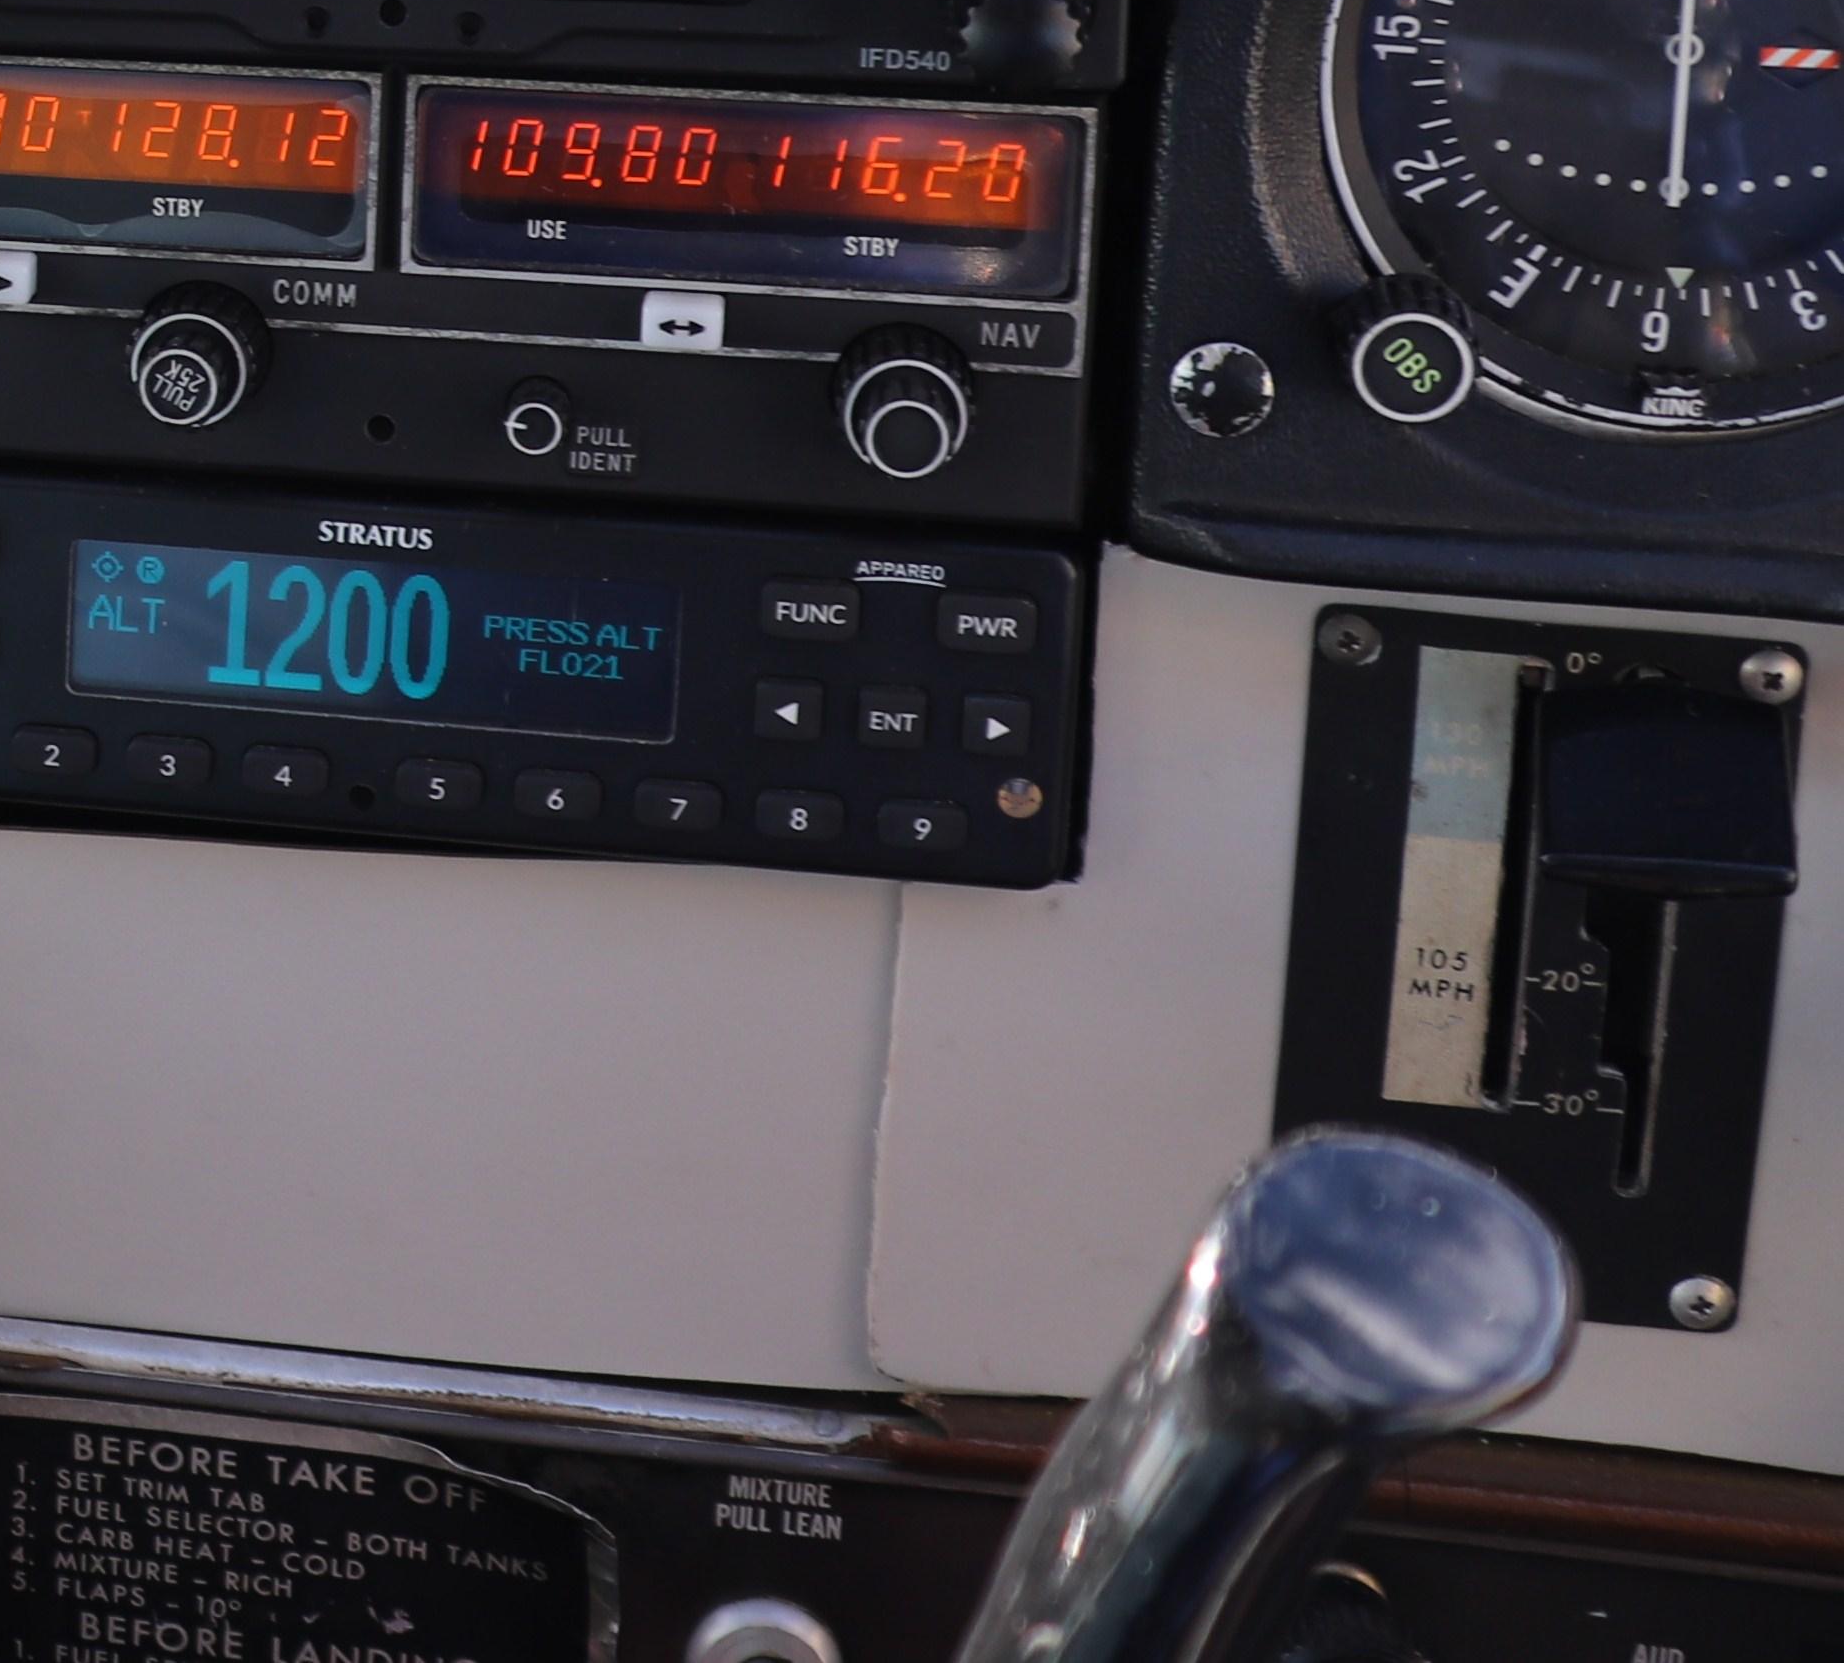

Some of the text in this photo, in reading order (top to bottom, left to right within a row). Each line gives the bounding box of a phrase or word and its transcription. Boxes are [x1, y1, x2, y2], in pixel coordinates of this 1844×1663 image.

[860, 48, 950, 72] IFD540
[113, 101, 347, 169] 128.12
[470, 118, 716, 188] 109.80
[772, 136, 1025, 203] 116.20
[152, 198, 203, 218] STBY
[273, 280, 356, 307] COMM
[981, 323, 1039, 348] NAV
[1382, 337, 1442, 394] OBS
[577, 426, 630, 447] PULL
[569, 450, 636, 472] IDENT
[319, 520, 433, 550] STRATUS
[856, 560, 945, 581] APPAREO
[775, 601, 847, 625] FUNC
[957, 614, 1017, 638] PWR
[207, 560, 450, 700] 1200
[483, 615, 661, 652] PRESS ALT
[519, 649, 623, 680] FL021
[869, 711, 917, 733] ENT
[1414, 948, 1468, 969] 105
[1408, 978, 1474, 1003] MPH
[73, 1434, 487, 1513] BEFORE TAKE OFF
[56, 1468, 265, 1513] SET TRIM TAB
[729, 1475, 832, 1509] MIXTURE
[716, 1503, 843, 1540] PULL LEAN
[55, 1521, 366, 1581] CARB HEAT COLD
[56, 1495, 549, 1583] FUEL SELECTOR BOTH TANKS
